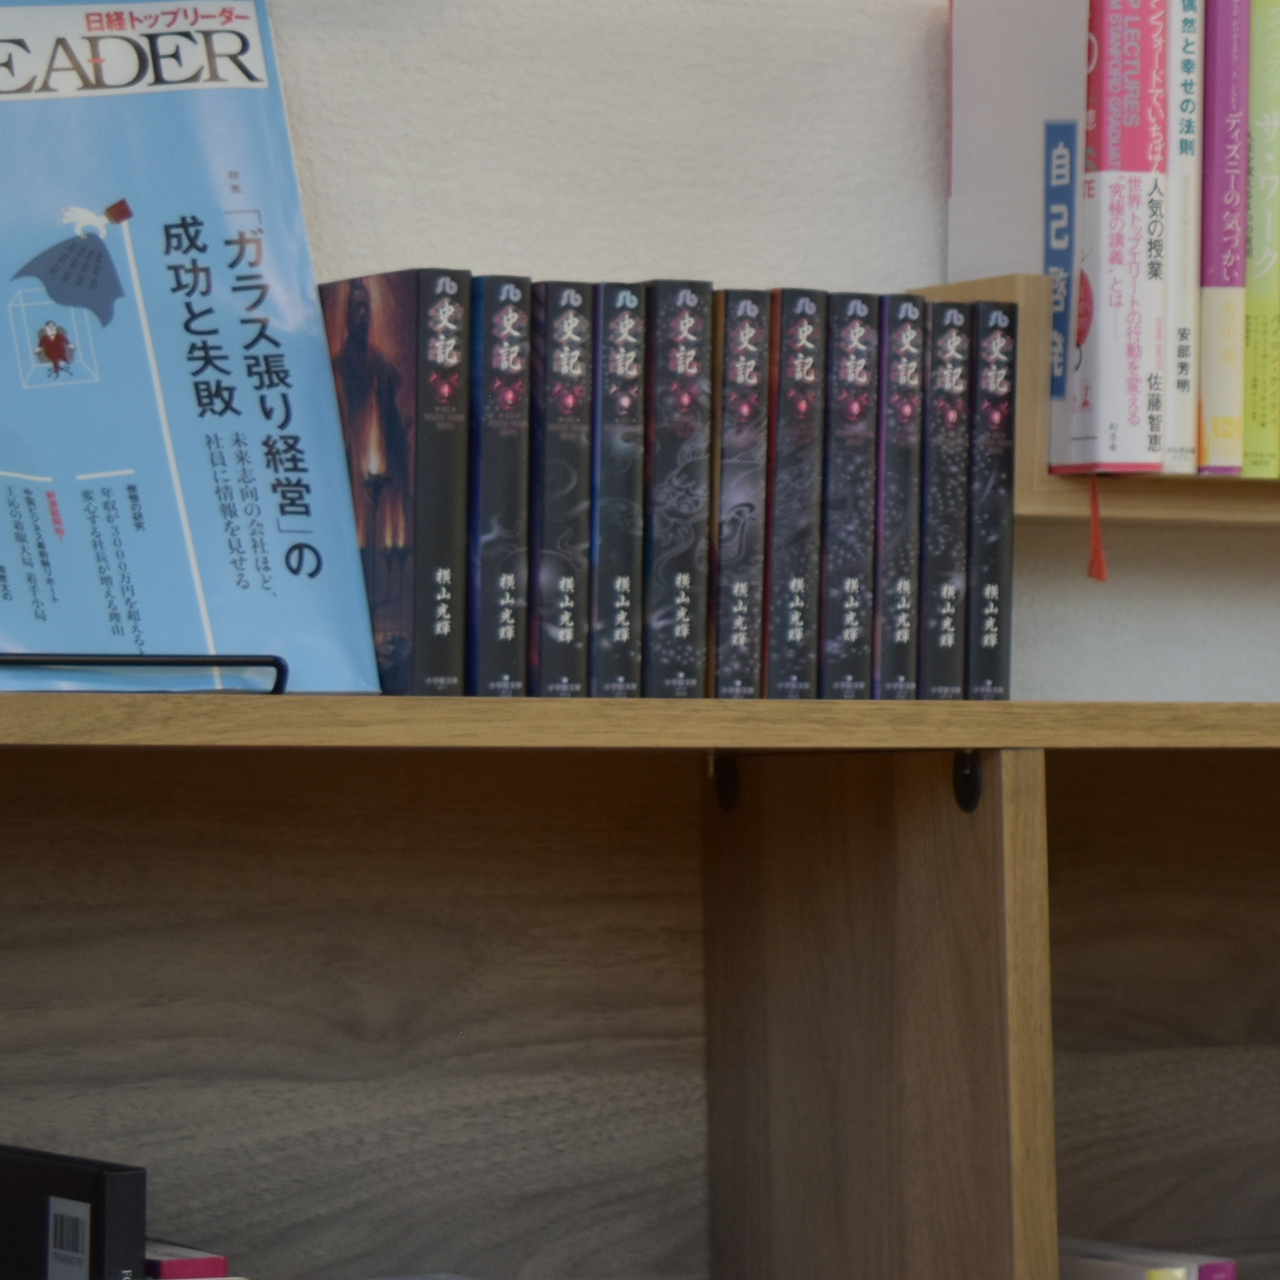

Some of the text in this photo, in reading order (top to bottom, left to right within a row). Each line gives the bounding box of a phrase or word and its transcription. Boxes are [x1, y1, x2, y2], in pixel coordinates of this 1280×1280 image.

[84, 6, 251, 33] 日経トップリーダー
[1108, 13, 1122, 94] STANFORD
[1123, 15, 1141, 128] LECTURES
[162, 215, 243, 419] 成功と失敗
[435, 300, 458, 365] 史記
[1125, 175, 1143, 426] 世界トップエリートの行動を変える
[499, 308, 522, 371] 史記
[559, 313, 583, 376] 史記
[614, 314, 638, 377] 史記
[675, 312, 698, 375] 史記
[735, 322, 758, 385] 史記
[793, 320, 815, 381] 史記
[846, 323, 868, 384] 史記
[897, 327, 919, 386] 史記
[942, 333, 964, 392] 史記
[987, 334, 1008, 394] 史記
[1176, 327, 1192, 394] 安部芳明
[223, 209, 324, 581] 「ガラス張り経営」の
[1147, 371, 1163, 453] 佐藤智恵
[204, 433, 252, 592] 社員に情報を見せる
[230, 430, 279, 599] 未来志向の会社ほど、
[434, 567, 452, 637] 横山光輝
[499, 573, 516, 642] 横山光輝
[558, 576, 575, 644] 横山光輝
[613, 575, 631, 643] 横山光輝
[674, 572, 691, 640] 横山光輝
[730, 581, 748, 648] 横山光輝
[787, 577, 805, 643] 横山光輝
[843, 577, 860, 643] 横山光輝
[894, 578, 911, 644] 横山光輝
[939, 583, 956, 648] 横山光輝
[982, 583, 1000, 648] 横山光輝
